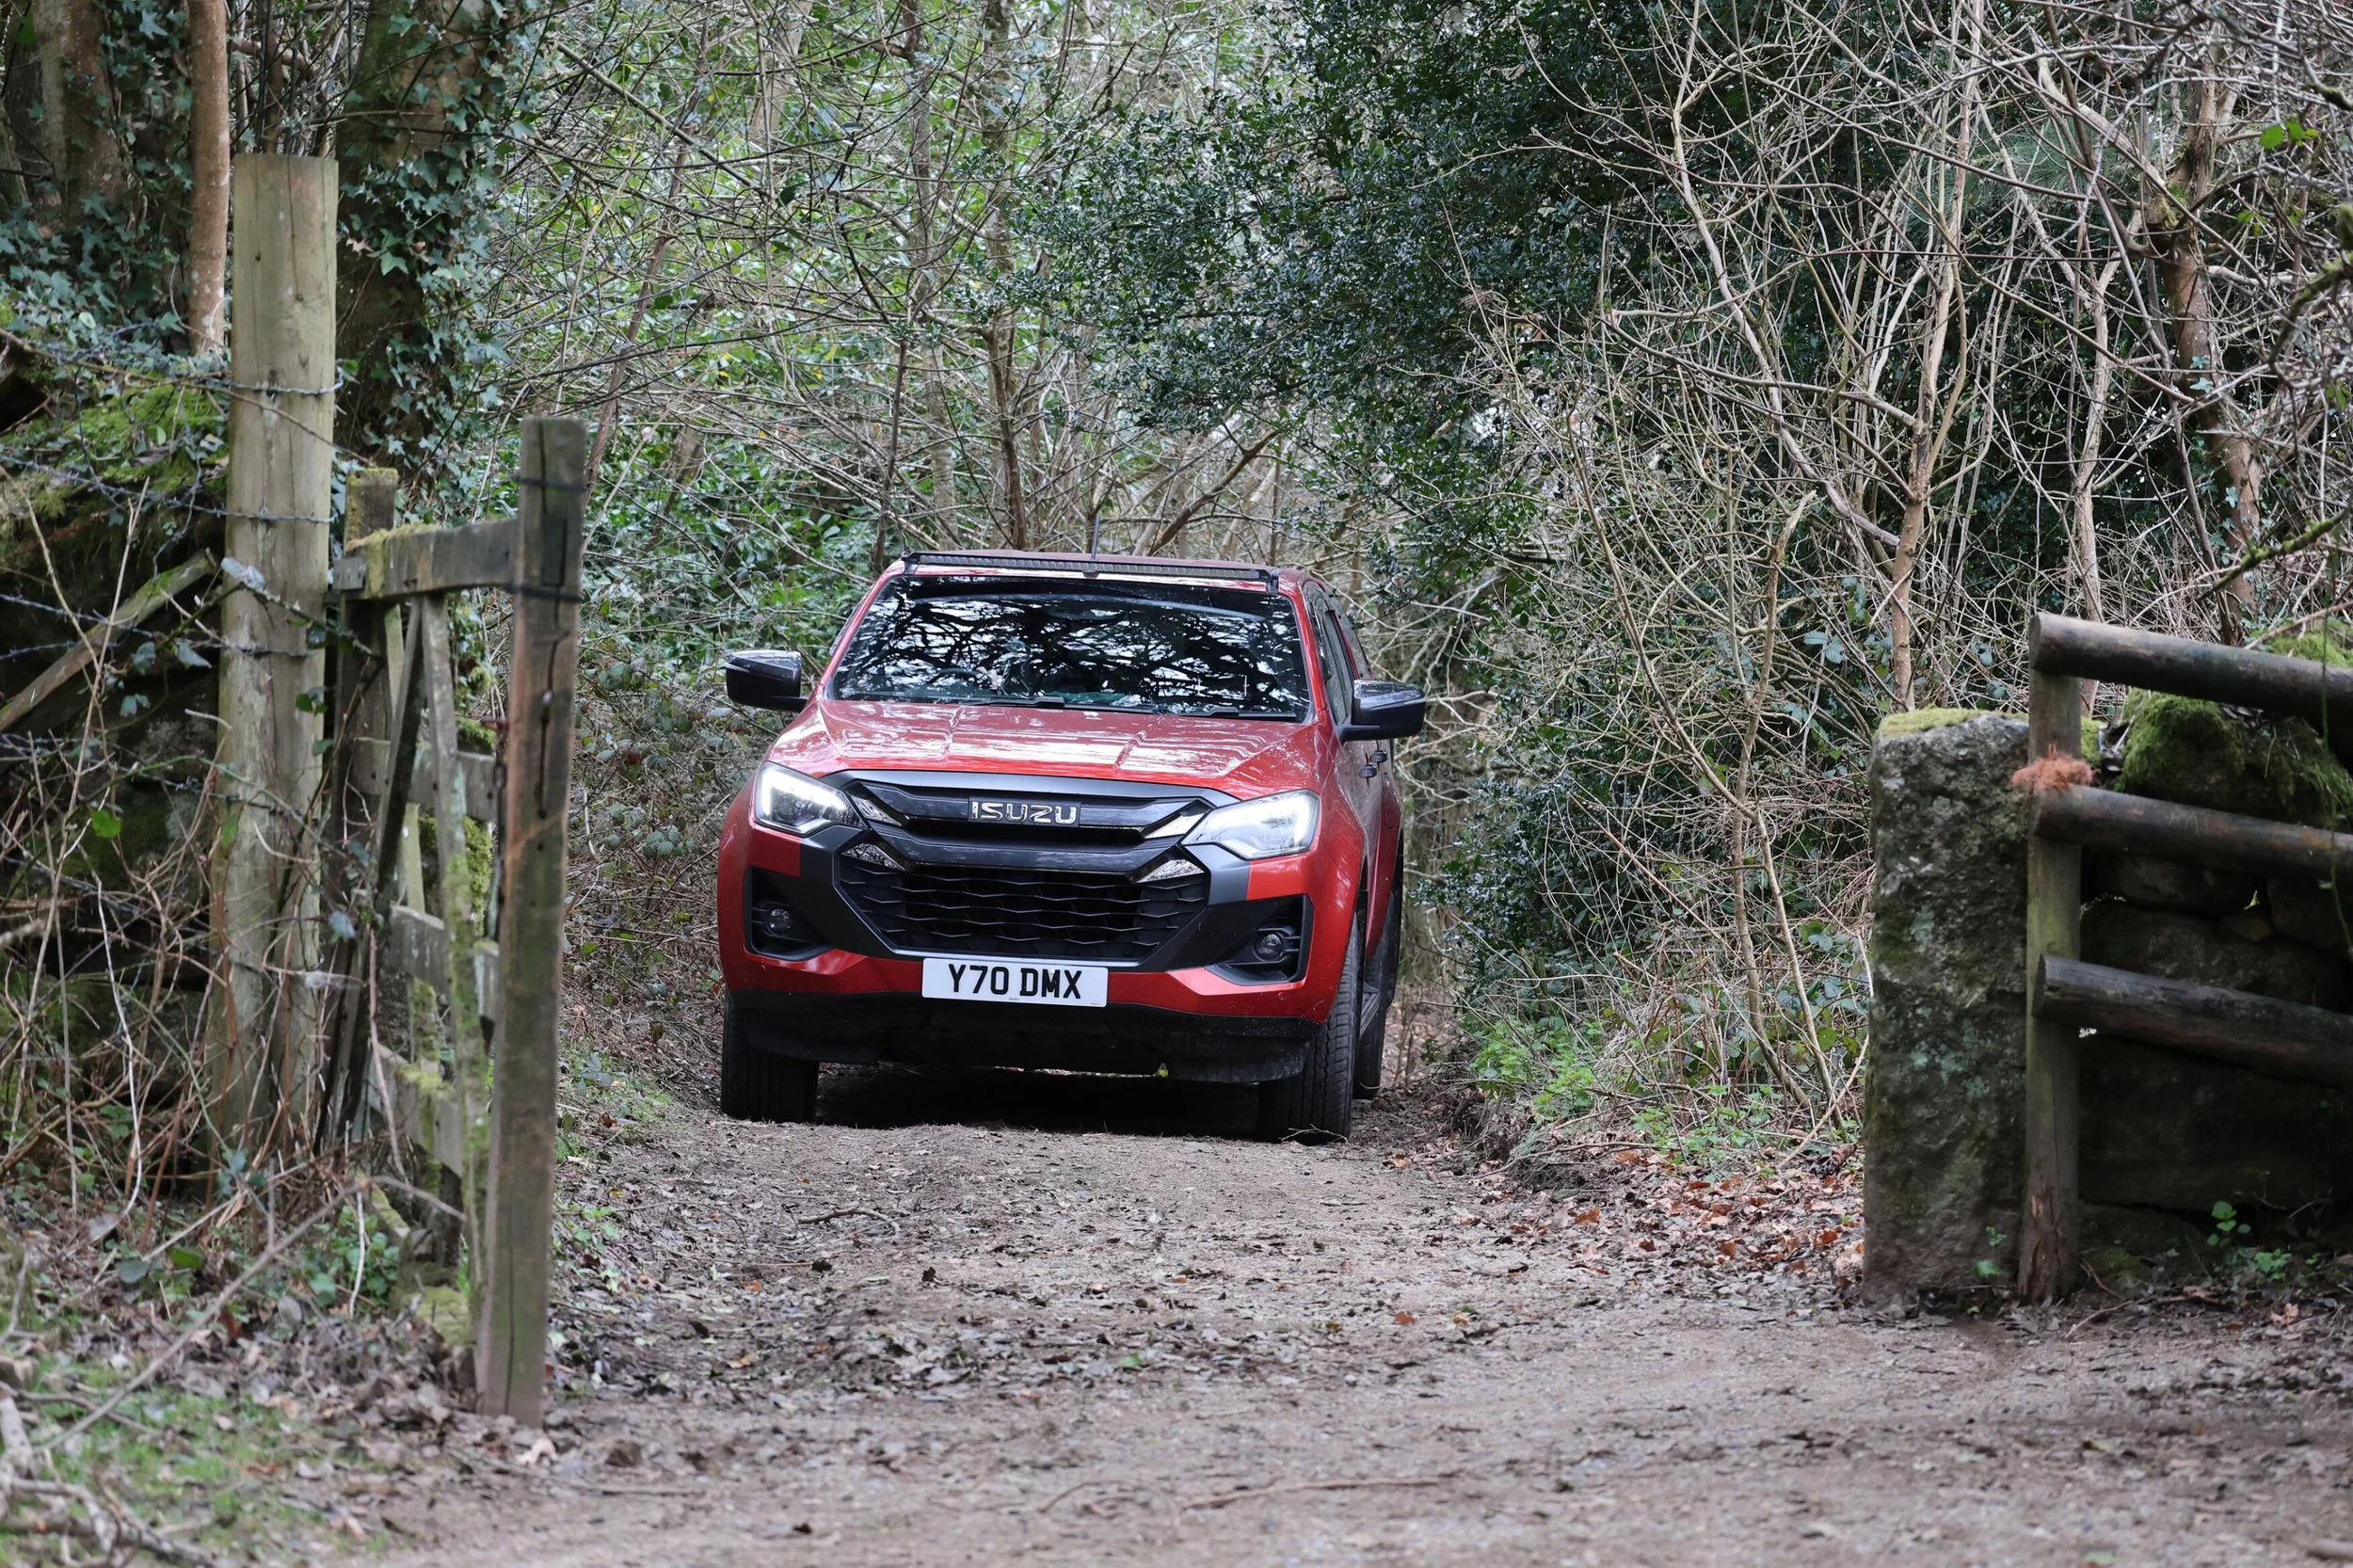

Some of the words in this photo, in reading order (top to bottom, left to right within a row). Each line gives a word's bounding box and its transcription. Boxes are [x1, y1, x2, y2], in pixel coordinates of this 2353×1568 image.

[971, 801, 1077, 824] ISUZU
[948, 964, 1010, 995] Y70
[1019, 968, 1082, 999] DMX
